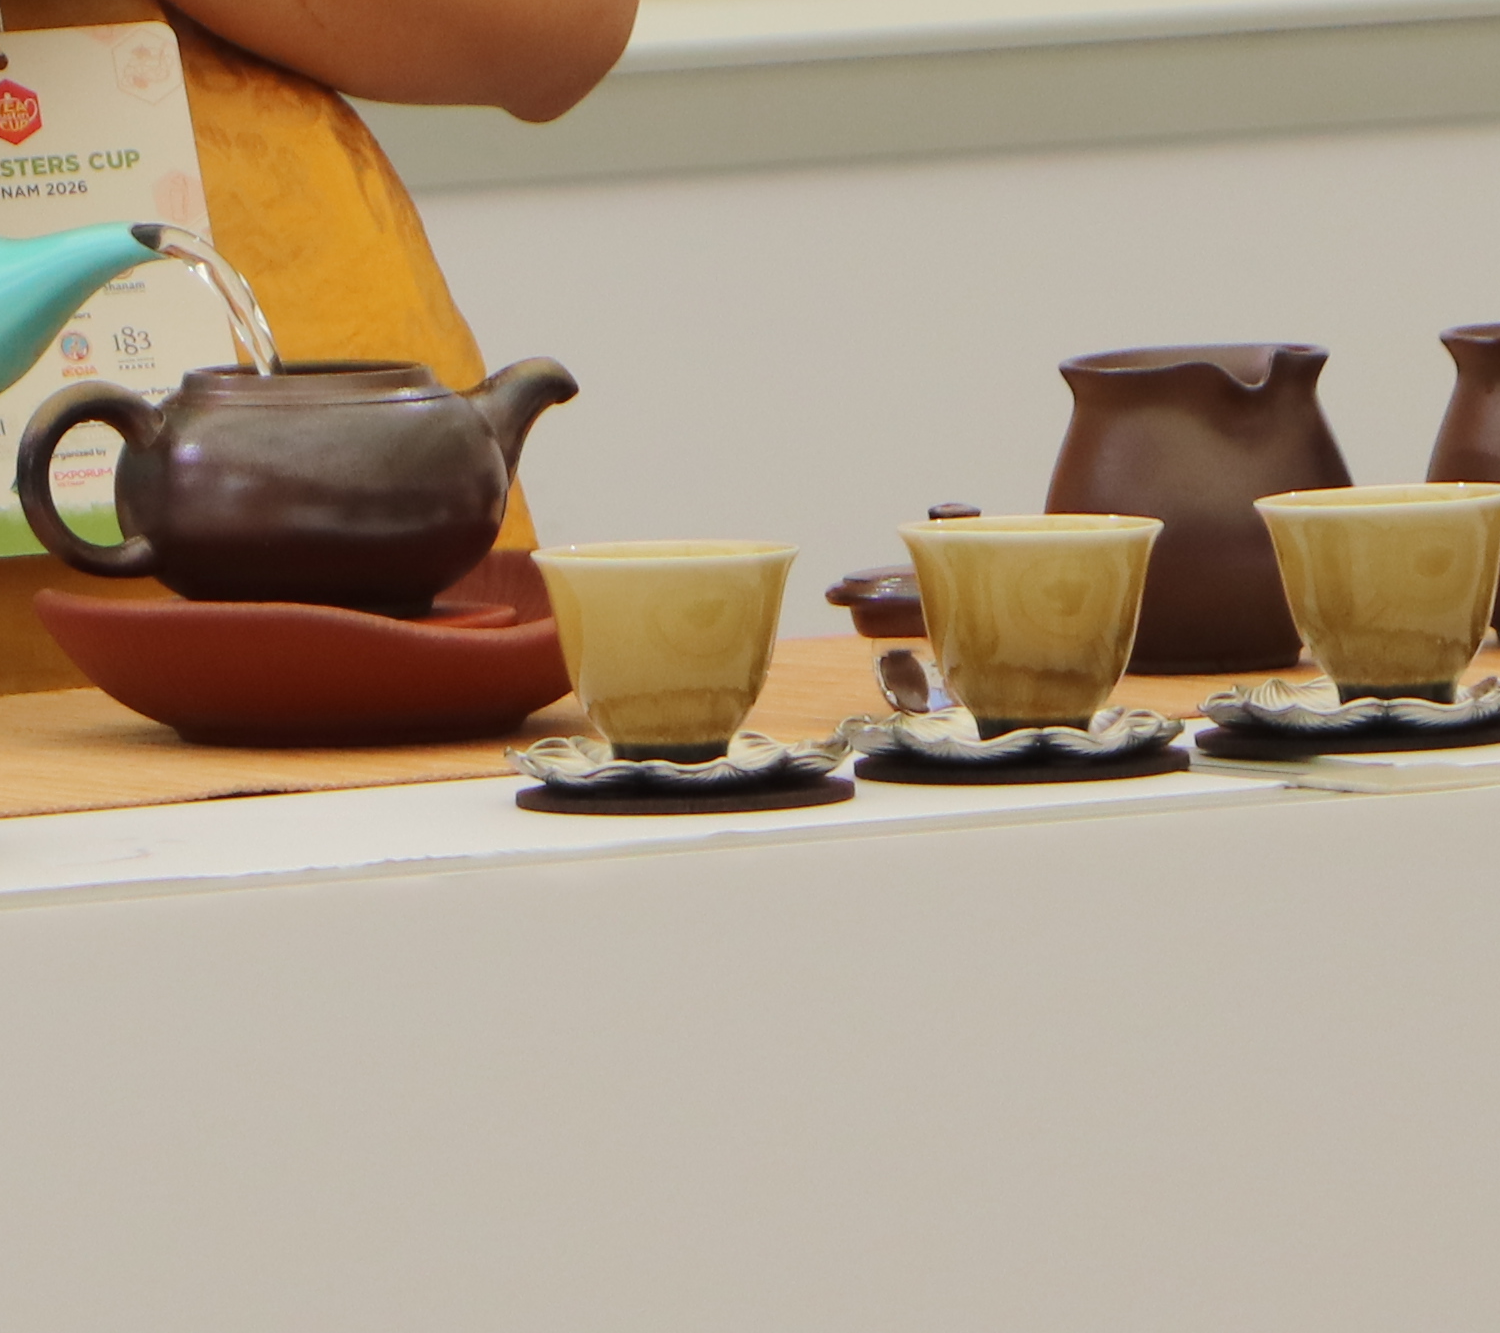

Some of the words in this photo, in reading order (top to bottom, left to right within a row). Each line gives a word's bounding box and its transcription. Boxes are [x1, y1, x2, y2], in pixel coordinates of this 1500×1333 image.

[88, 148, 141, 172] CUP
[47, 180, 89, 196] 2026
[113, 325, 152, 355] 1883
[53, 467, 113, 481] EXPORUM
